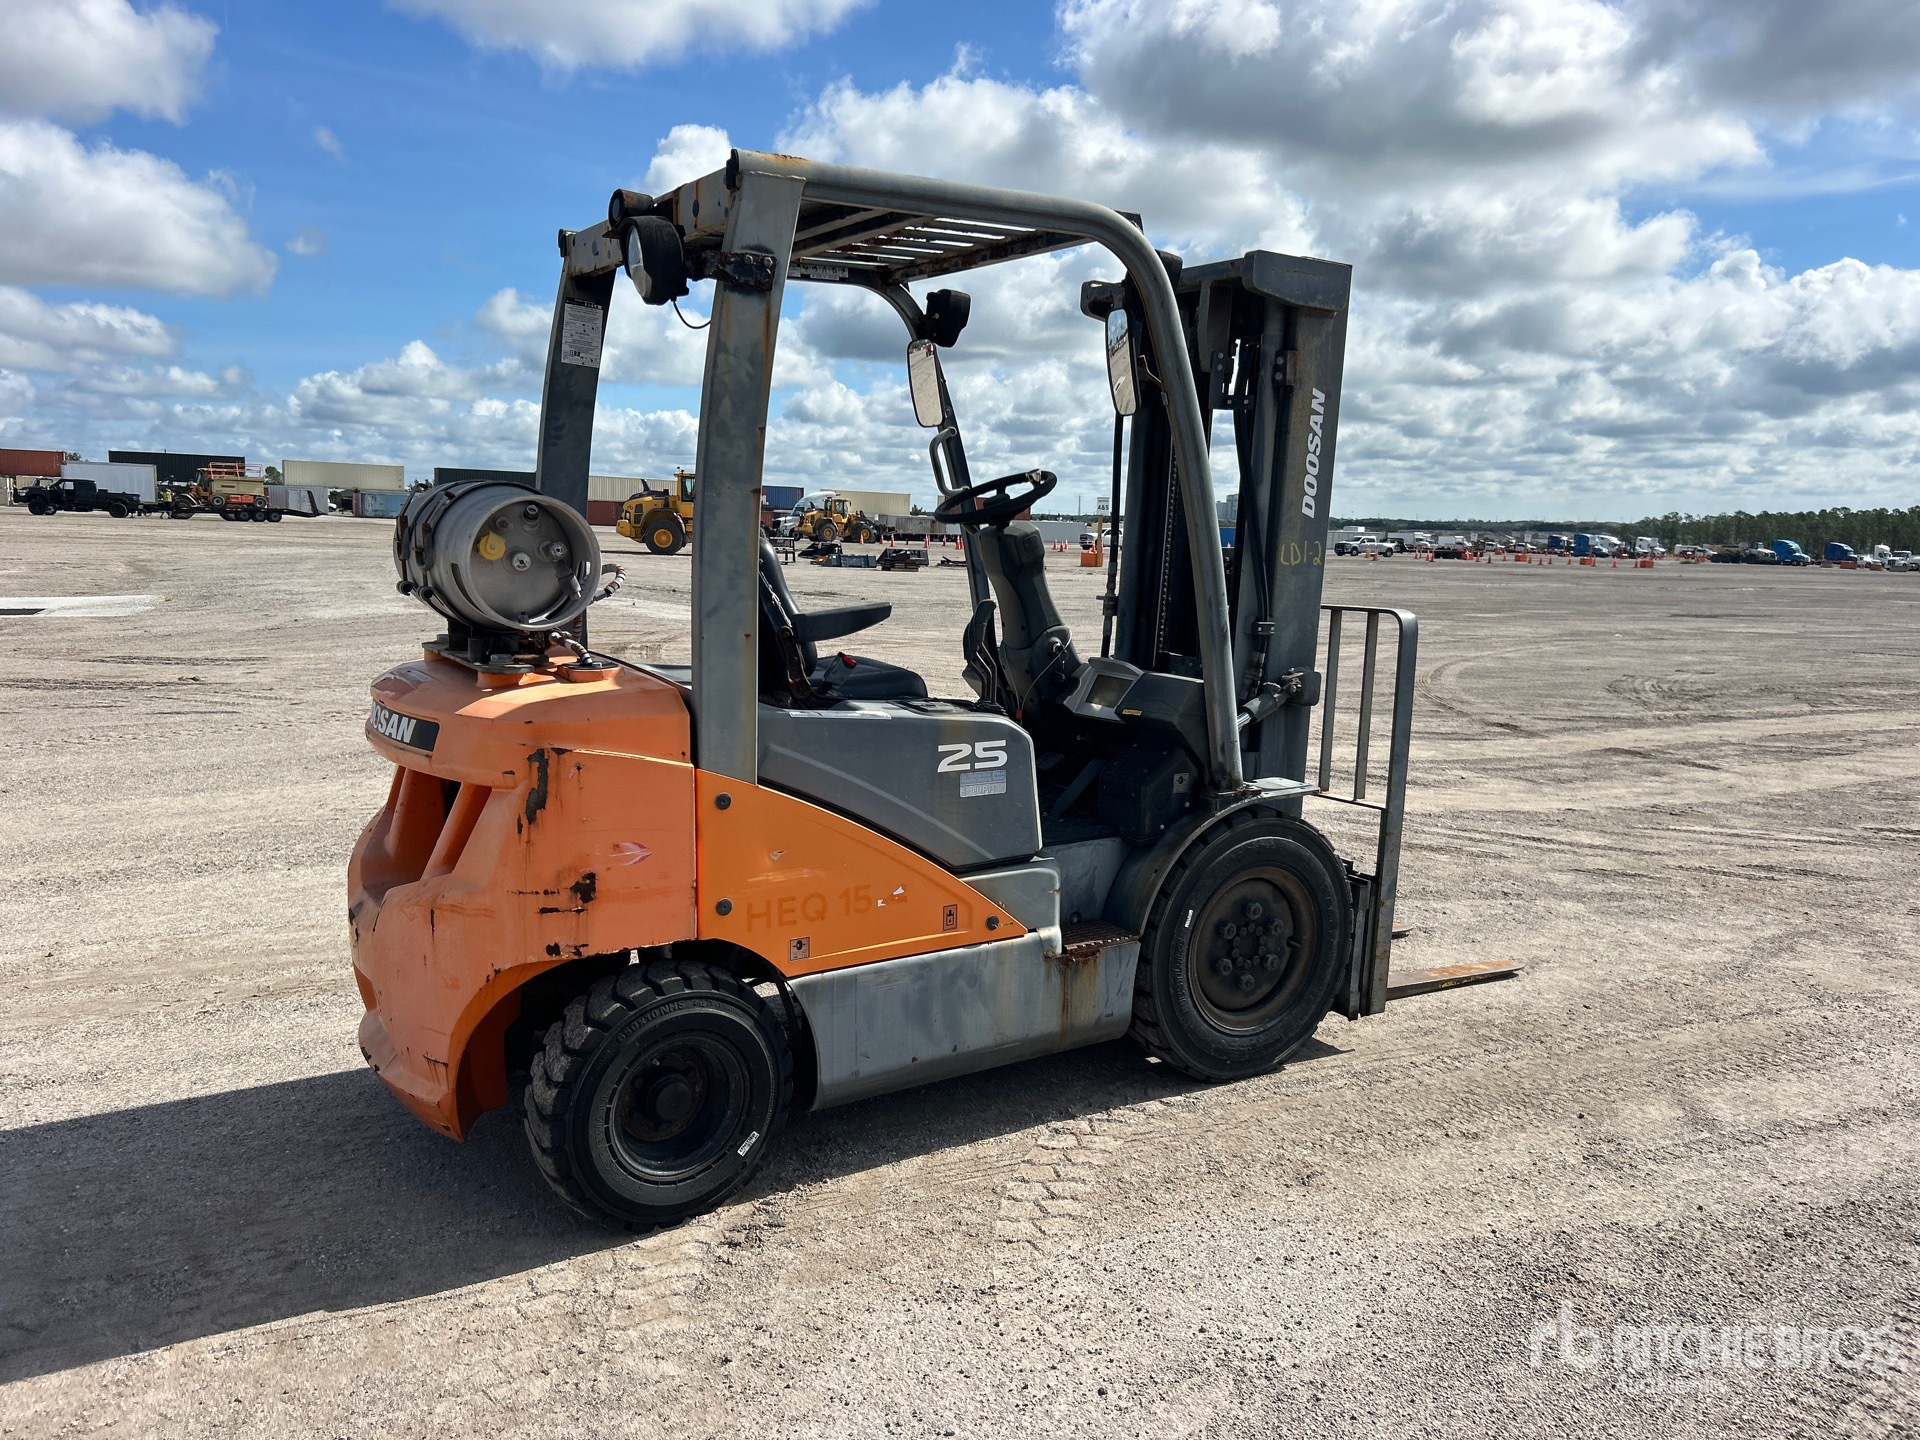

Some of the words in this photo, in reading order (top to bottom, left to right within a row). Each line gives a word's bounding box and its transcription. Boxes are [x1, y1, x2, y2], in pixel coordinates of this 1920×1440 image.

[1302, 387, 1326, 519] DOOSAN
[937, 740, 1008, 773] 25
[745, 891, 828, 933] HEQ
